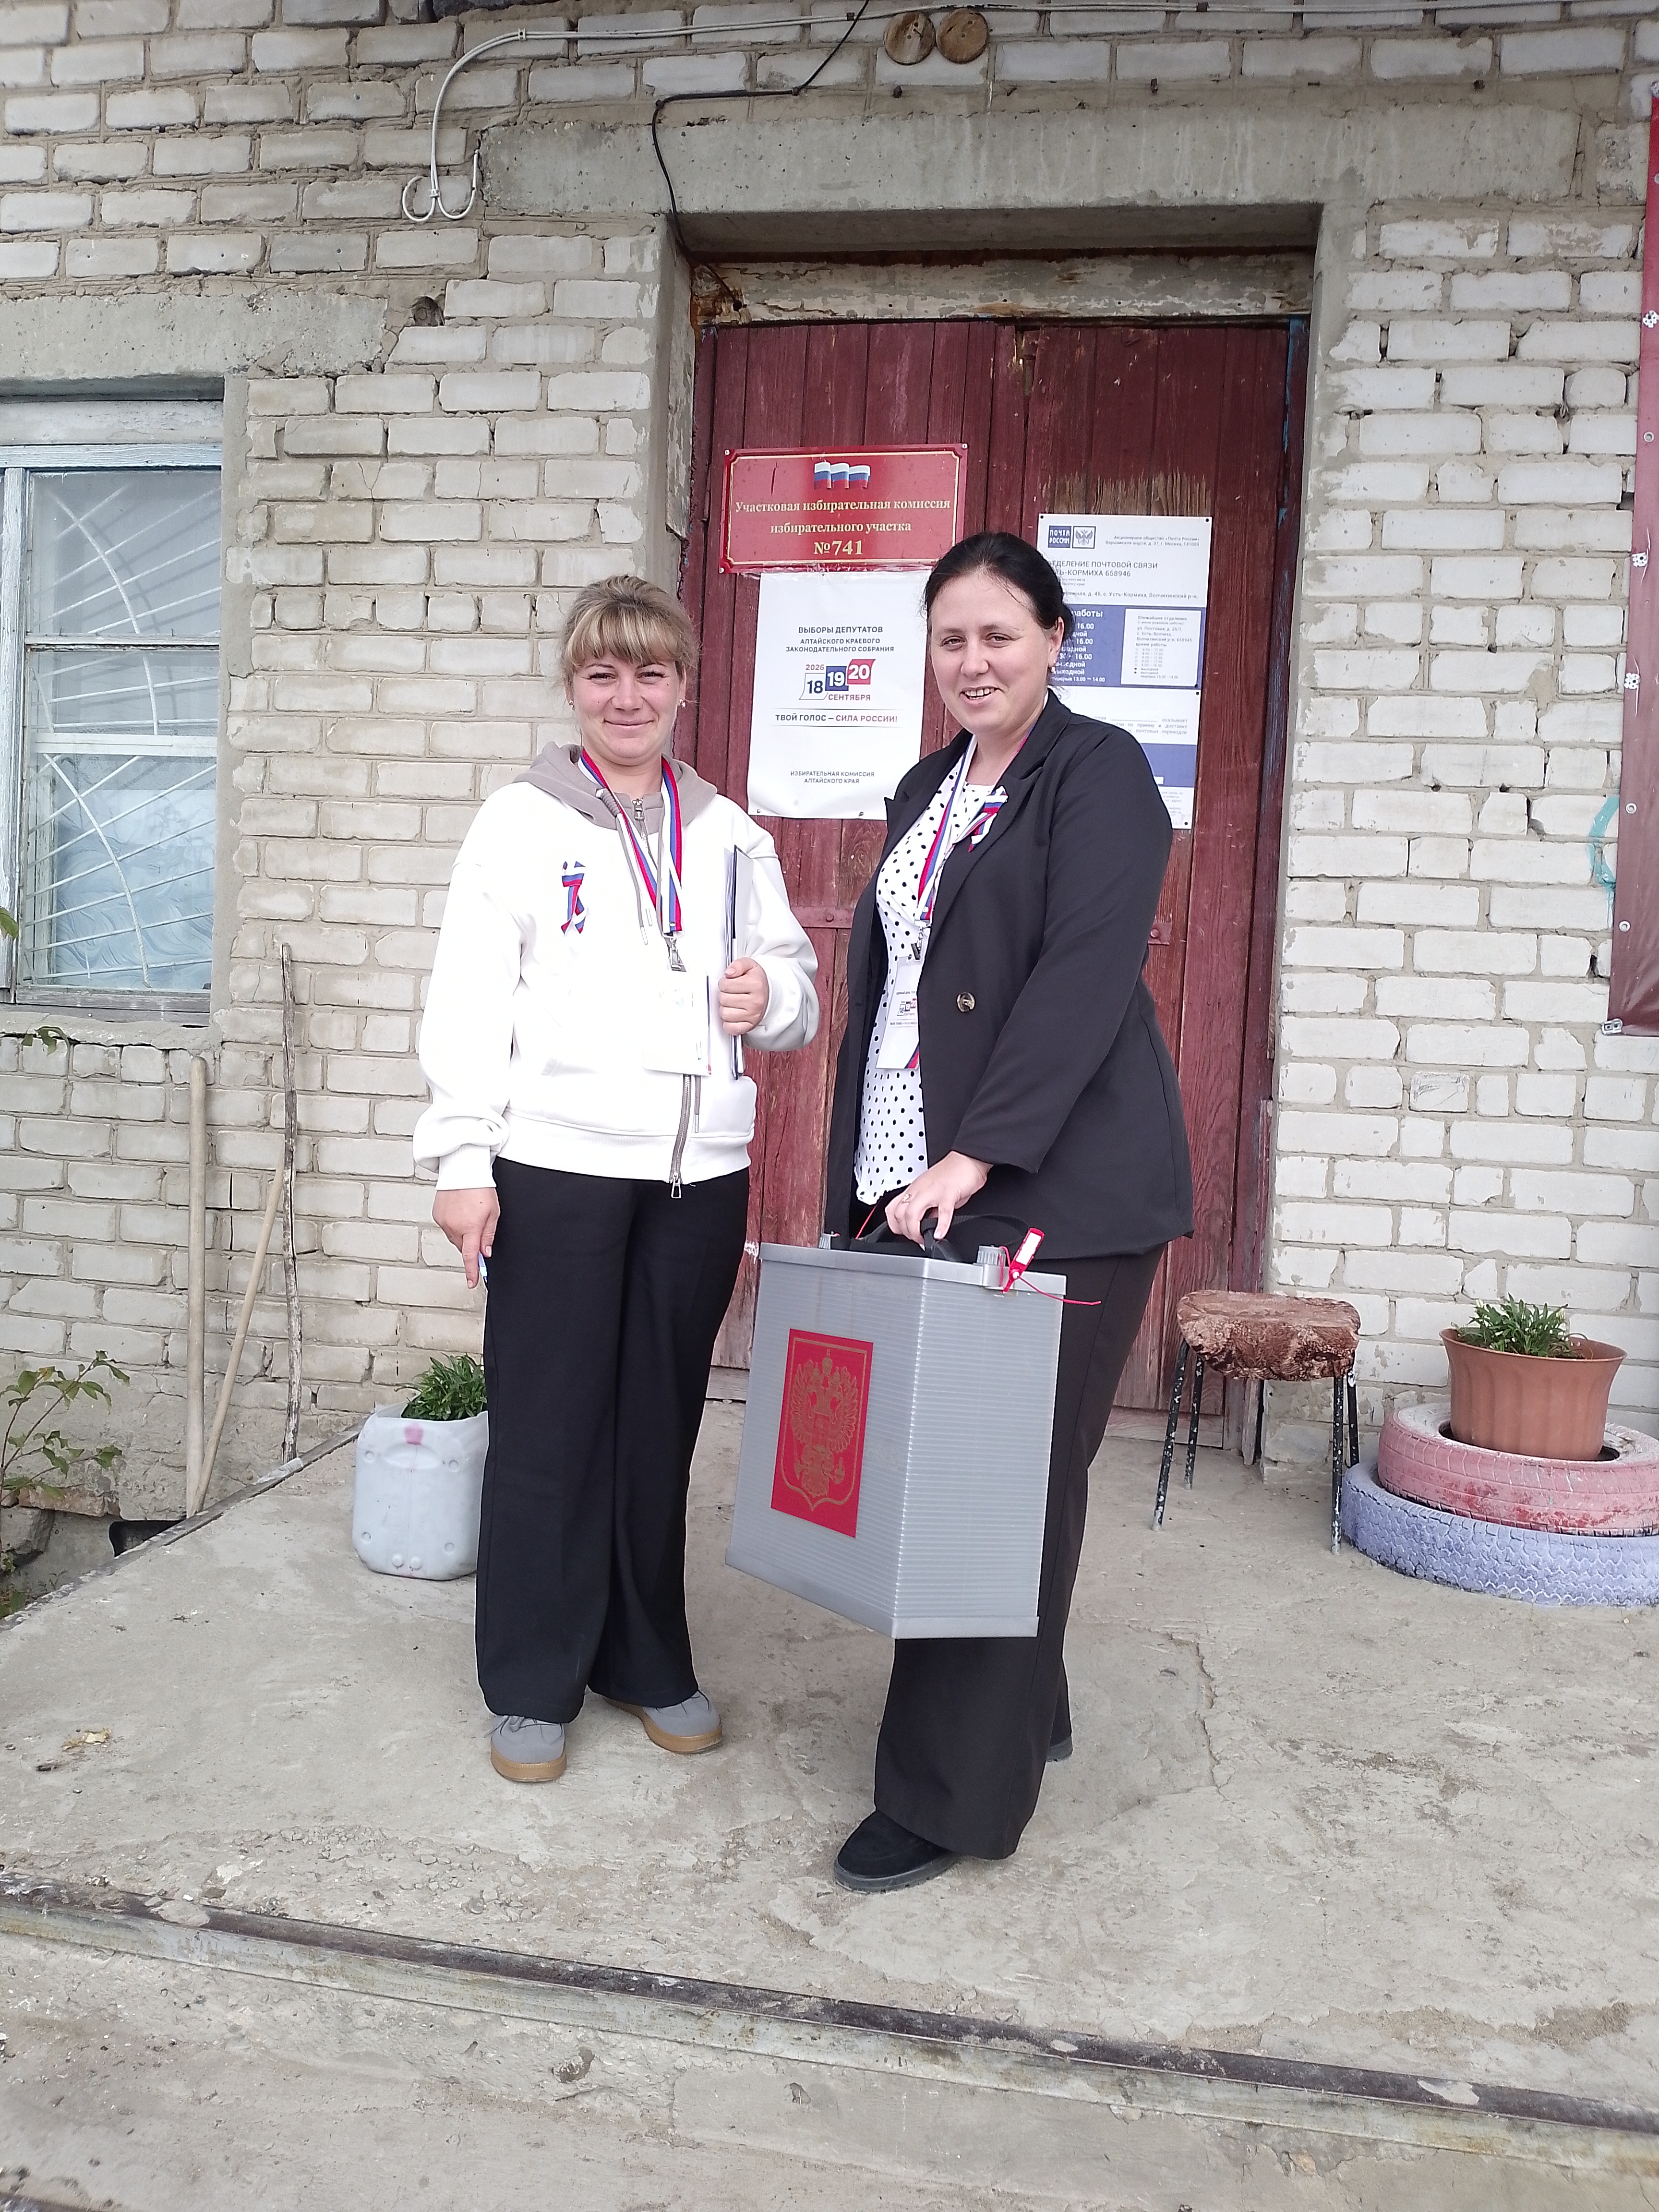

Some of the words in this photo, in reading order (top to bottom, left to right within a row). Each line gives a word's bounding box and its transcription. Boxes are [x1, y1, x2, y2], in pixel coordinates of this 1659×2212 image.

[735, 502, 800, 512] Участковая
[803, 499, 891, 513] избирательная
[893, 500, 950, 509] комиссия
[770, 522, 864, 536] избирательного
[866, 523, 912, 534] участка
[813, 540, 863, 555] №741
[835, 626, 883, 634] ДЕПУТАТОВ
[807, 680, 823, 694] 18
[827, 671, 845, 687] 19
[848, 664, 870, 680] 20
[775, 713, 797, 721] ТВОЙ
